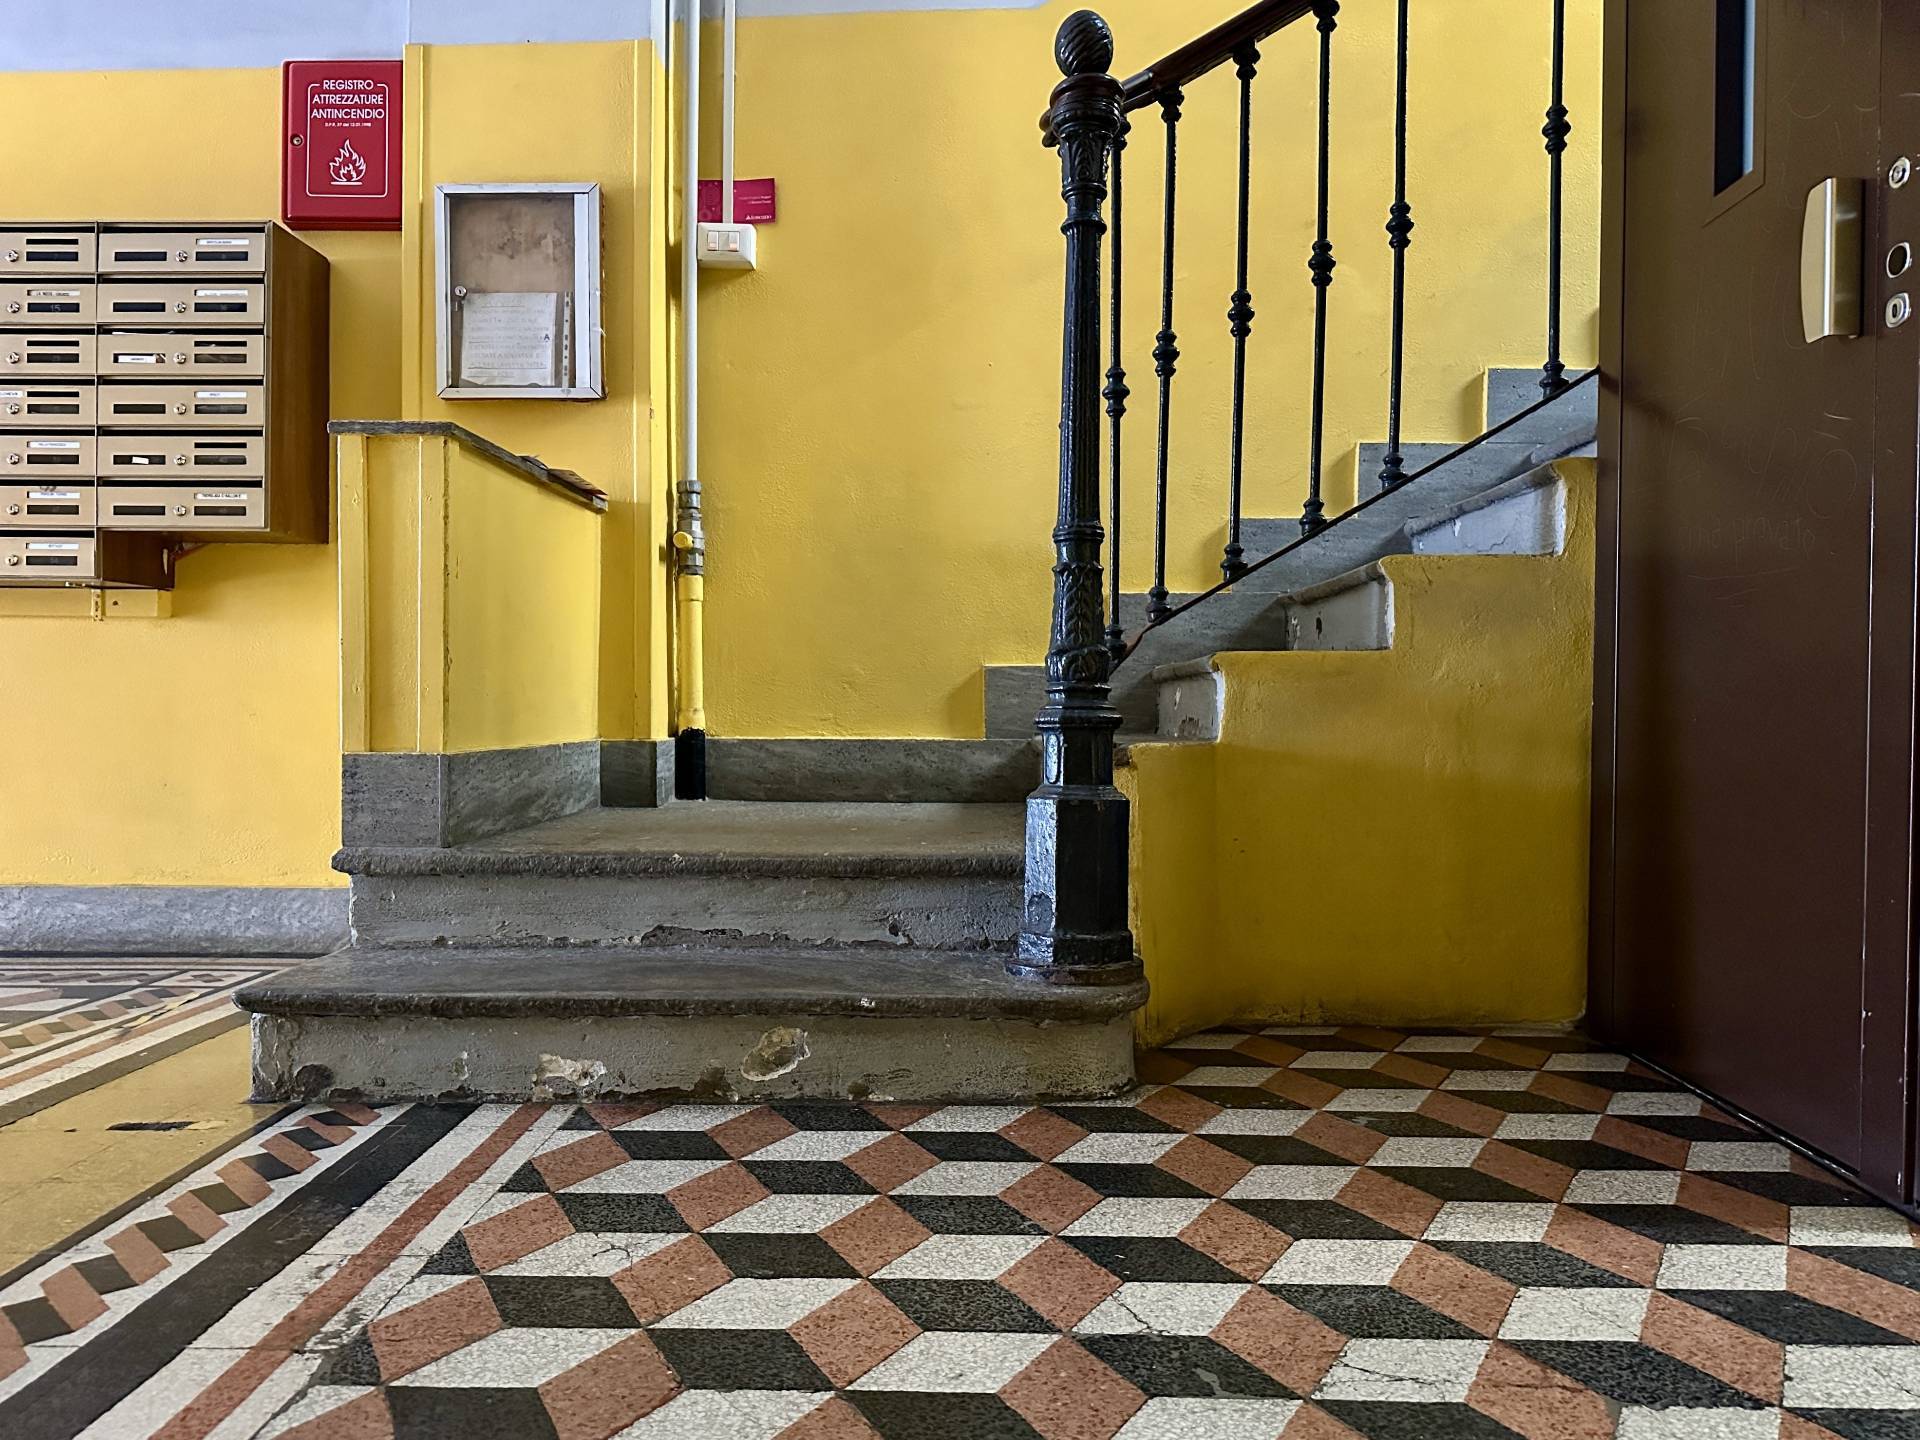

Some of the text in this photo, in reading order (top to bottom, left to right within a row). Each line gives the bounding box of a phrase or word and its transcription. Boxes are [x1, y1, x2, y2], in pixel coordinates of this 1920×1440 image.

[323, 80, 374, 90] REGISTRO
[312, 94, 384, 105] ATTREZZATURE
[311, 108, 385, 119] ANTINCENDIO
